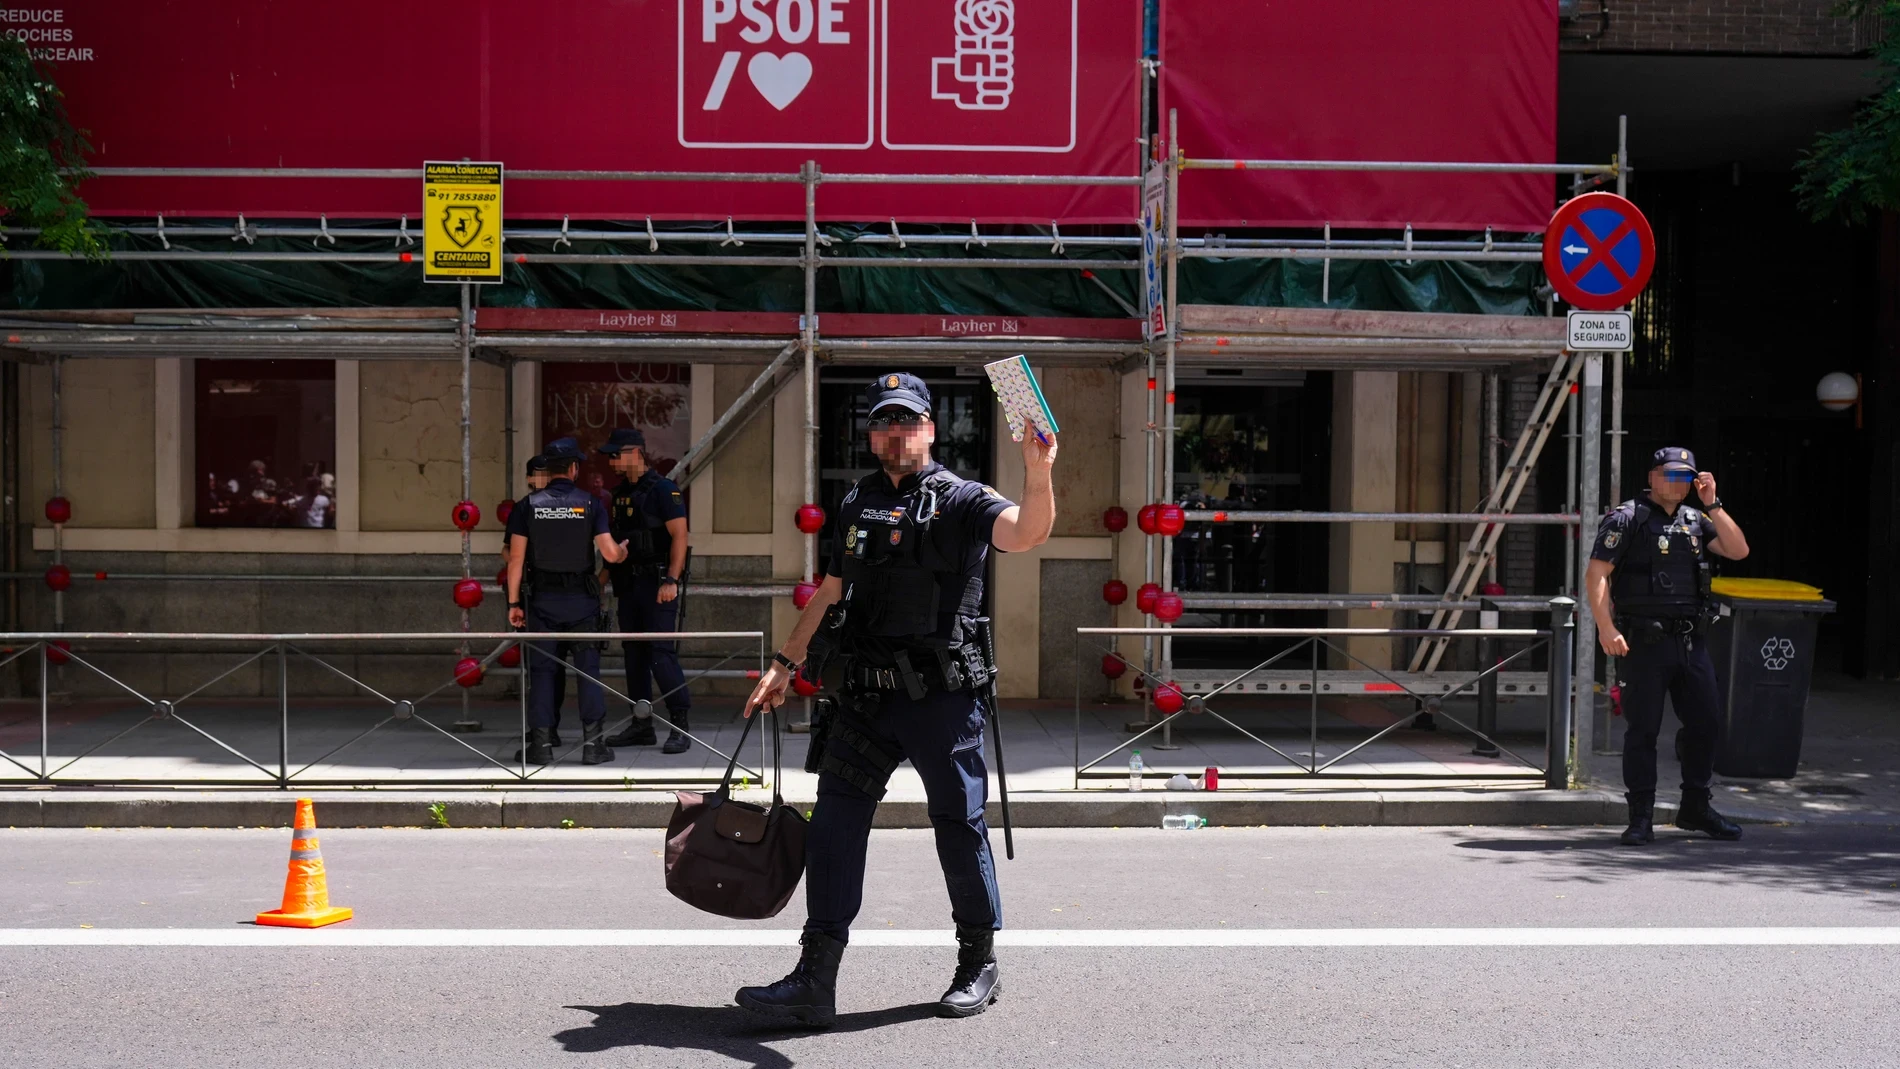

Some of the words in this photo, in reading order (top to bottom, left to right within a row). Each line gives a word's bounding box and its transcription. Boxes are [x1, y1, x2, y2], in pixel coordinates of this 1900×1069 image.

[0, 9, 64, 23] REDUCE
[702, 0, 850, 44] PSOE
[427, 166, 456, 174] ALARMA
[457, 167, 499, 175] CONECTADA
[438, 193, 449, 201] 91
[453, 193, 497, 202] 7853880
[436, 252, 489, 262] CENTAURO
[600, 313, 655, 328] Layher
[1579, 320, 1605, 329] ZONA
[1608, 321, 1621, 330] DE
[941, 319, 996, 334] Layher
[1573, 333, 1627, 342] SEGURIDAD
[554, 393, 691, 429] NUNCA
[859, 513, 898, 522] NACIONAL
